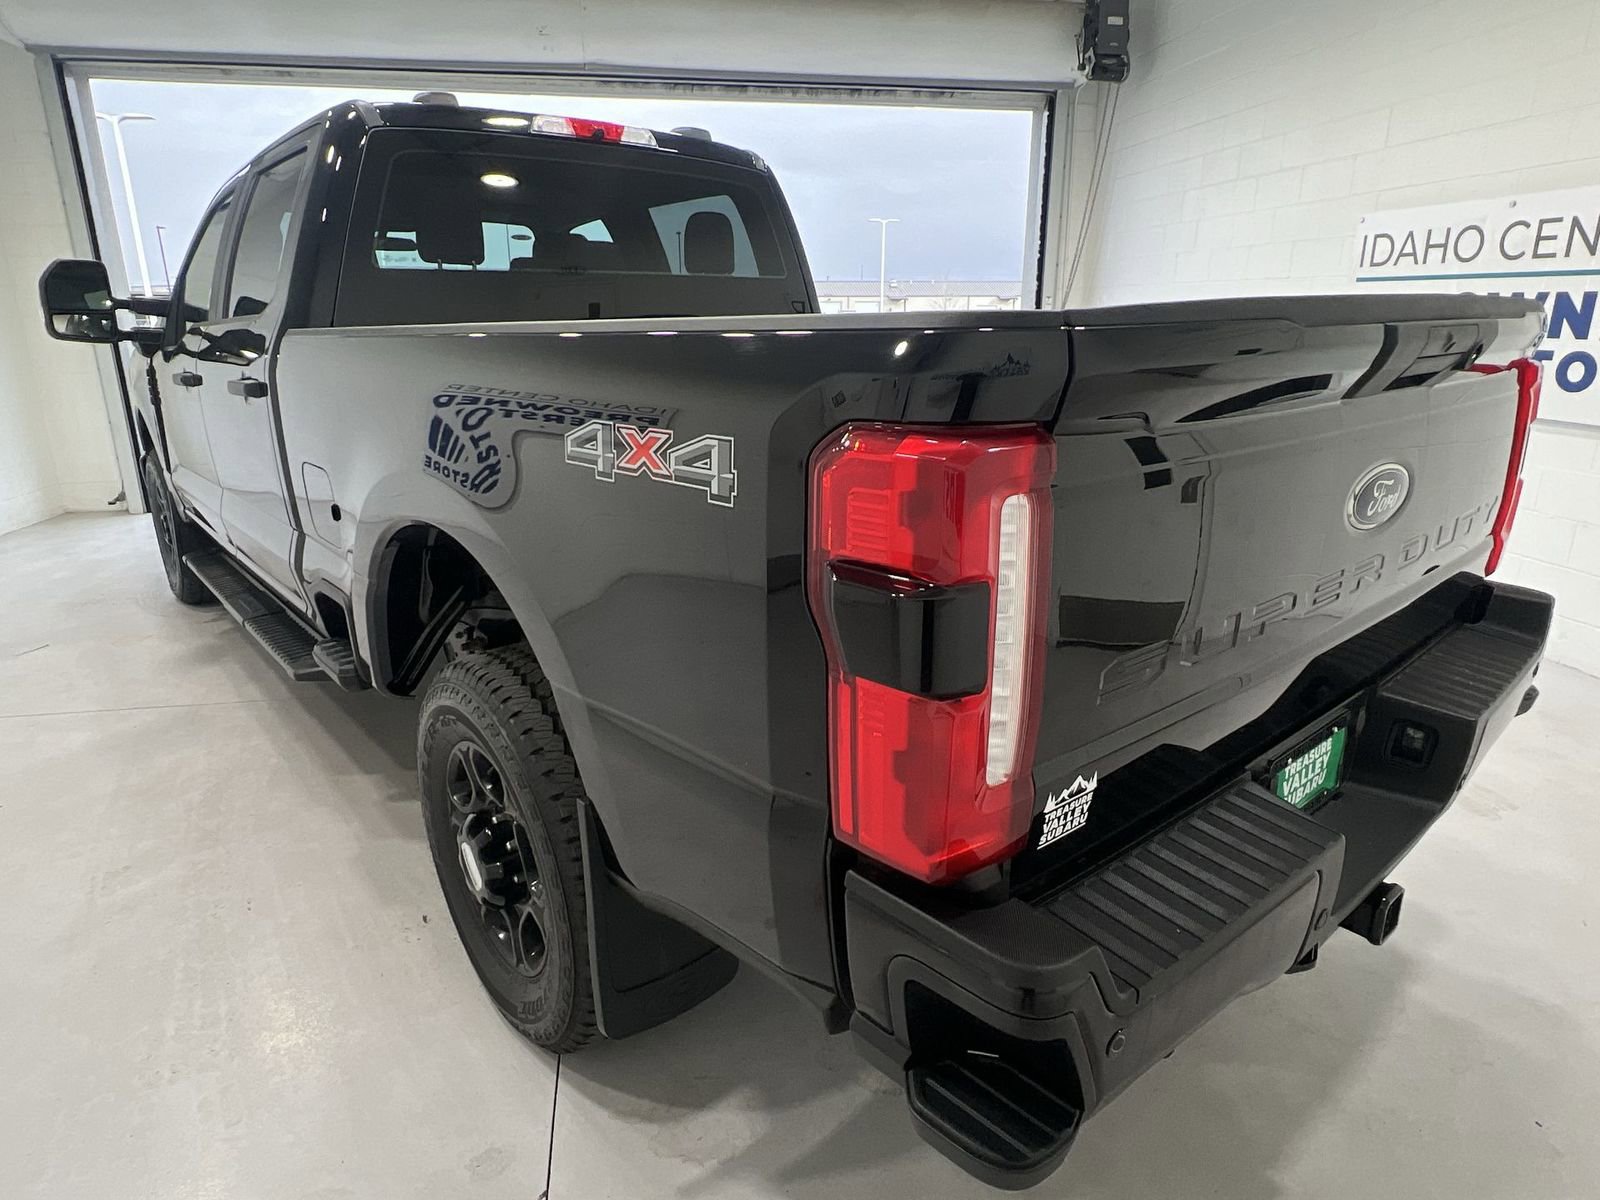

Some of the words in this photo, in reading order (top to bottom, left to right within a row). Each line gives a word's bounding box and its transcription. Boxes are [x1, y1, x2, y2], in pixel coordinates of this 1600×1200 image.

[1359, 224, 1485, 269] IDAHO
[1499, 215, 1600, 261] CEN
[1367, 479, 1402, 517] Ford
[1097, 553, 1386, 705] SUPER
[1397, 495, 1499, 571] DUTY
[1282, 751, 1331, 797] VALLEY
[1284, 737, 1333, 779] TREASURE
[1283, 768, 1328, 805] UBARU
[1043, 800, 1092, 834] VALLEY
[1044, 791, 1094, 823] TREASURE
[1038, 811, 1089, 846] SUBARU
